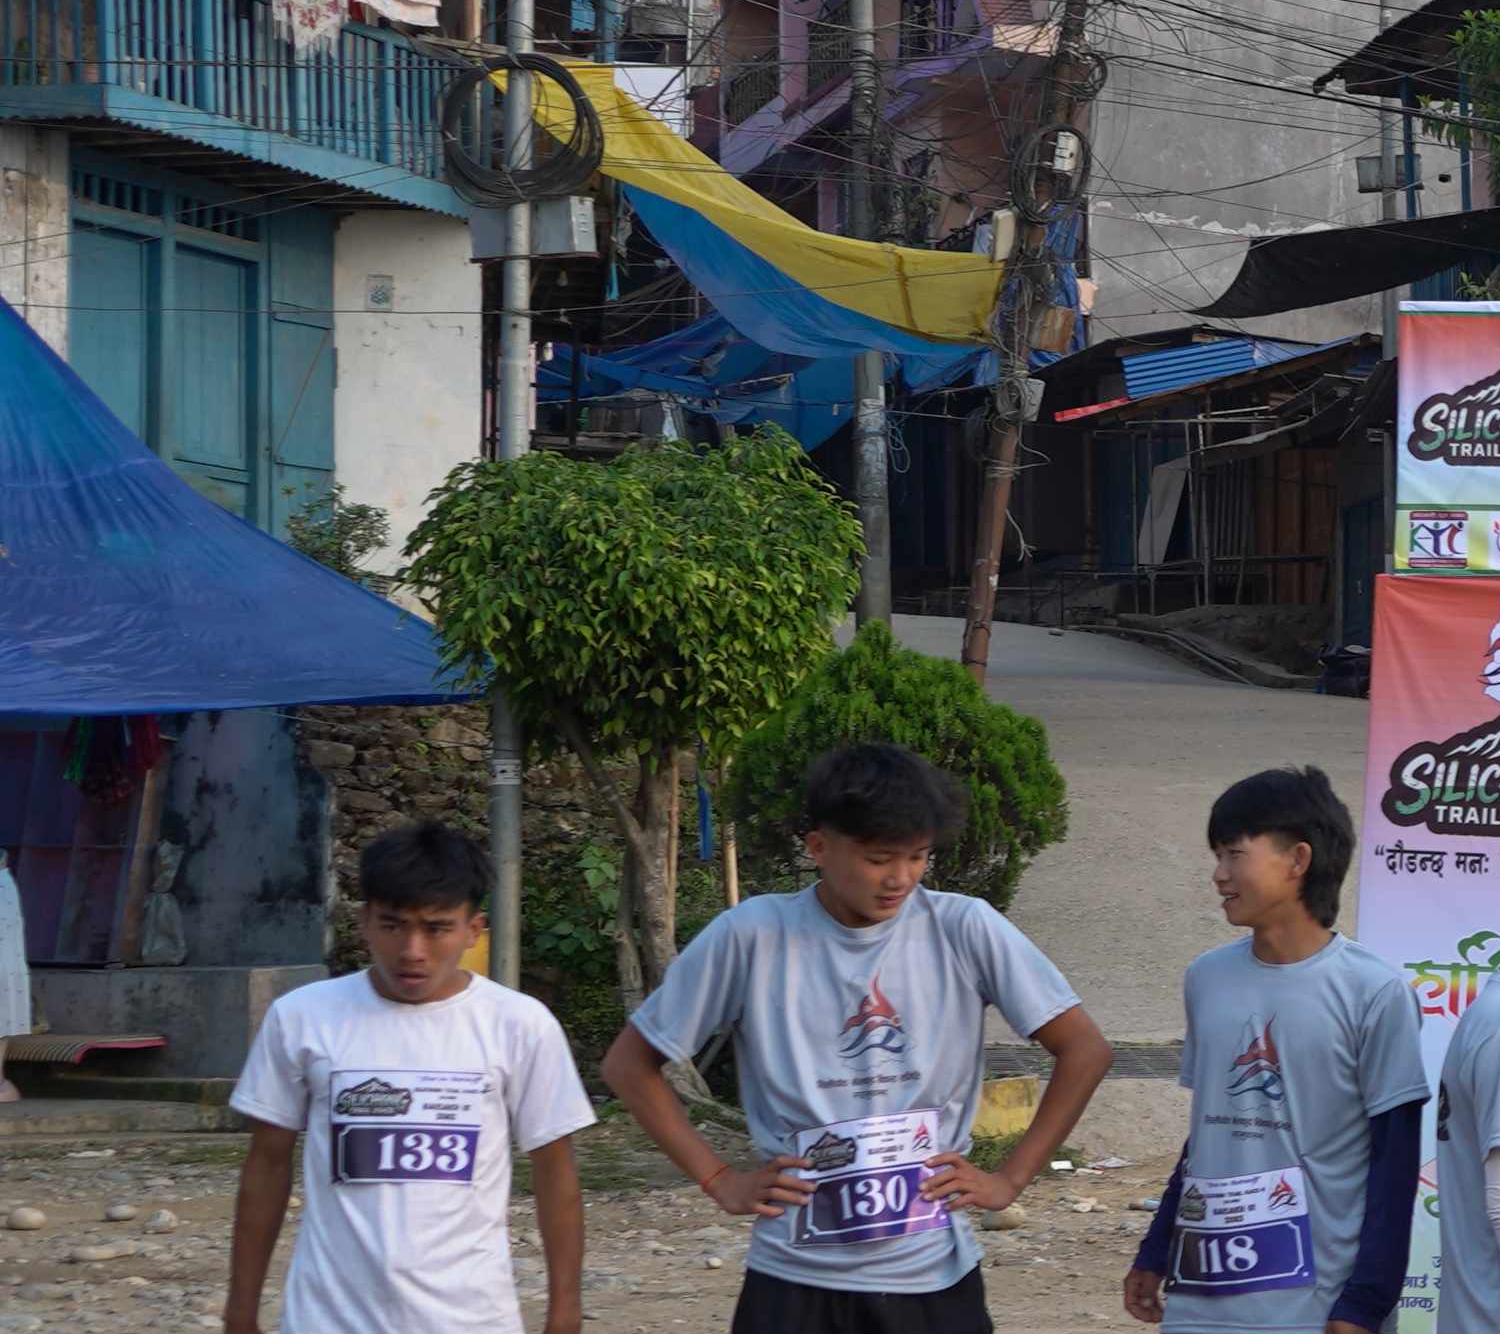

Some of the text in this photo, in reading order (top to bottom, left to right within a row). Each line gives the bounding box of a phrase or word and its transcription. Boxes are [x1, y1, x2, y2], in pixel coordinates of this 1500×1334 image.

[378, 1133, 470, 1172] 133
[839, 1175, 908, 1220] 130
[1199, 1235, 1259, 1274] 118
